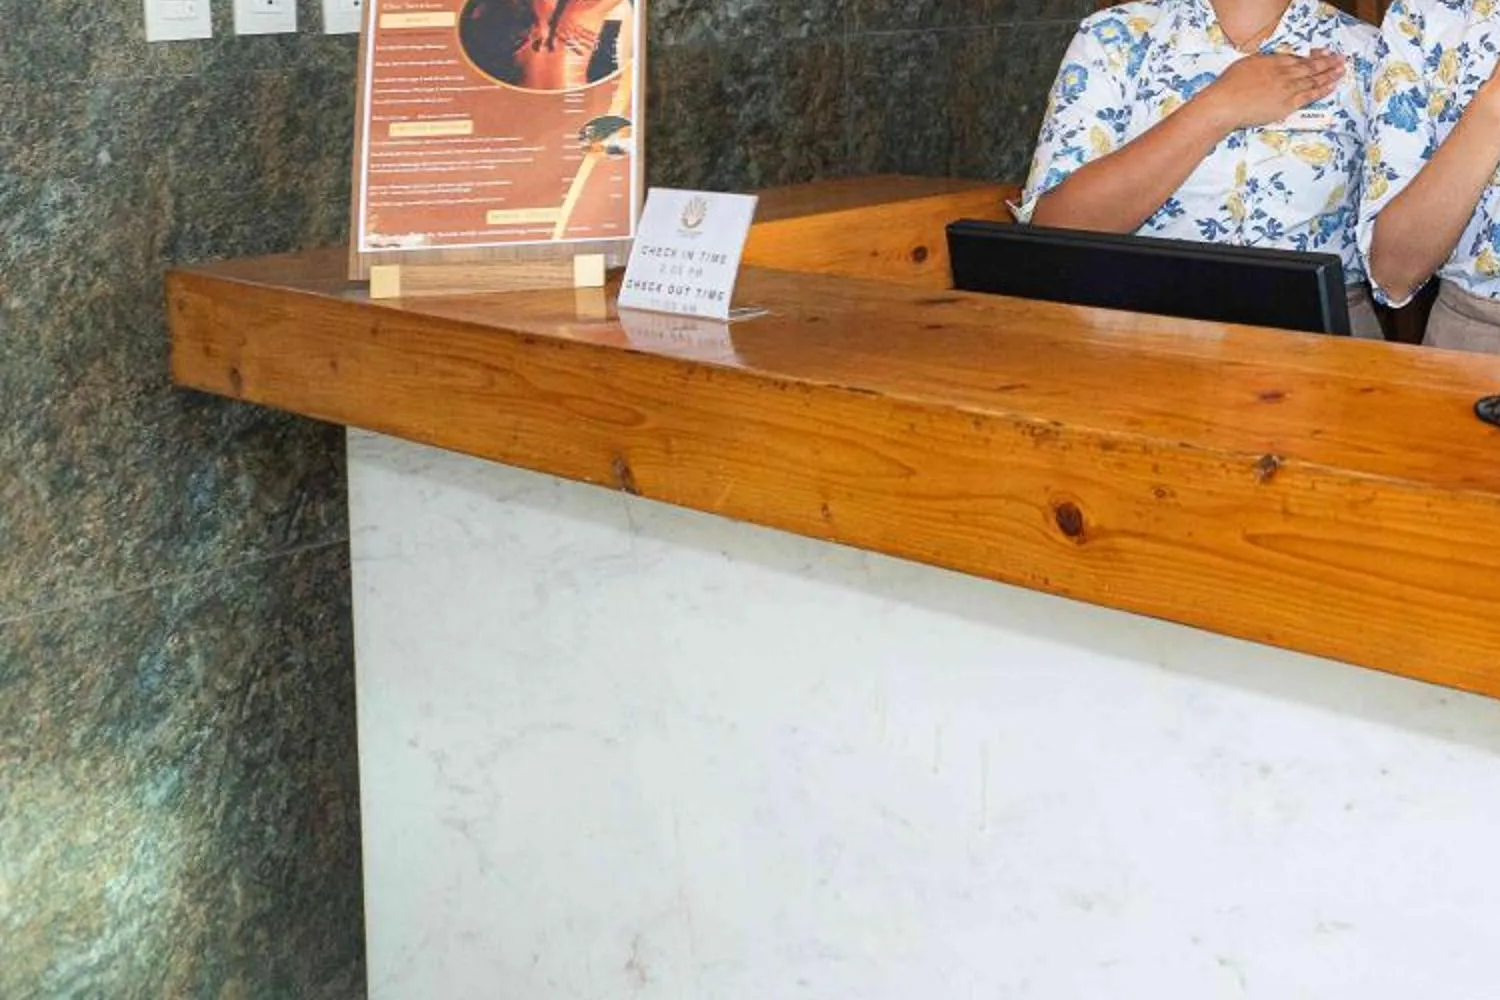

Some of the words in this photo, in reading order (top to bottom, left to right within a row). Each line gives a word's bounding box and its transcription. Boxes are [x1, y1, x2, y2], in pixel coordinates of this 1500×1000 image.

[640, 245, 678, 258] CHECK
[681, 249, 695, 260] IN
[700, 251, 729, 265] TIME
[626, 279, 663, 294] CHECK
[667, 284, 691, 296] OUT
[696, 288, 726, 301] TIME
